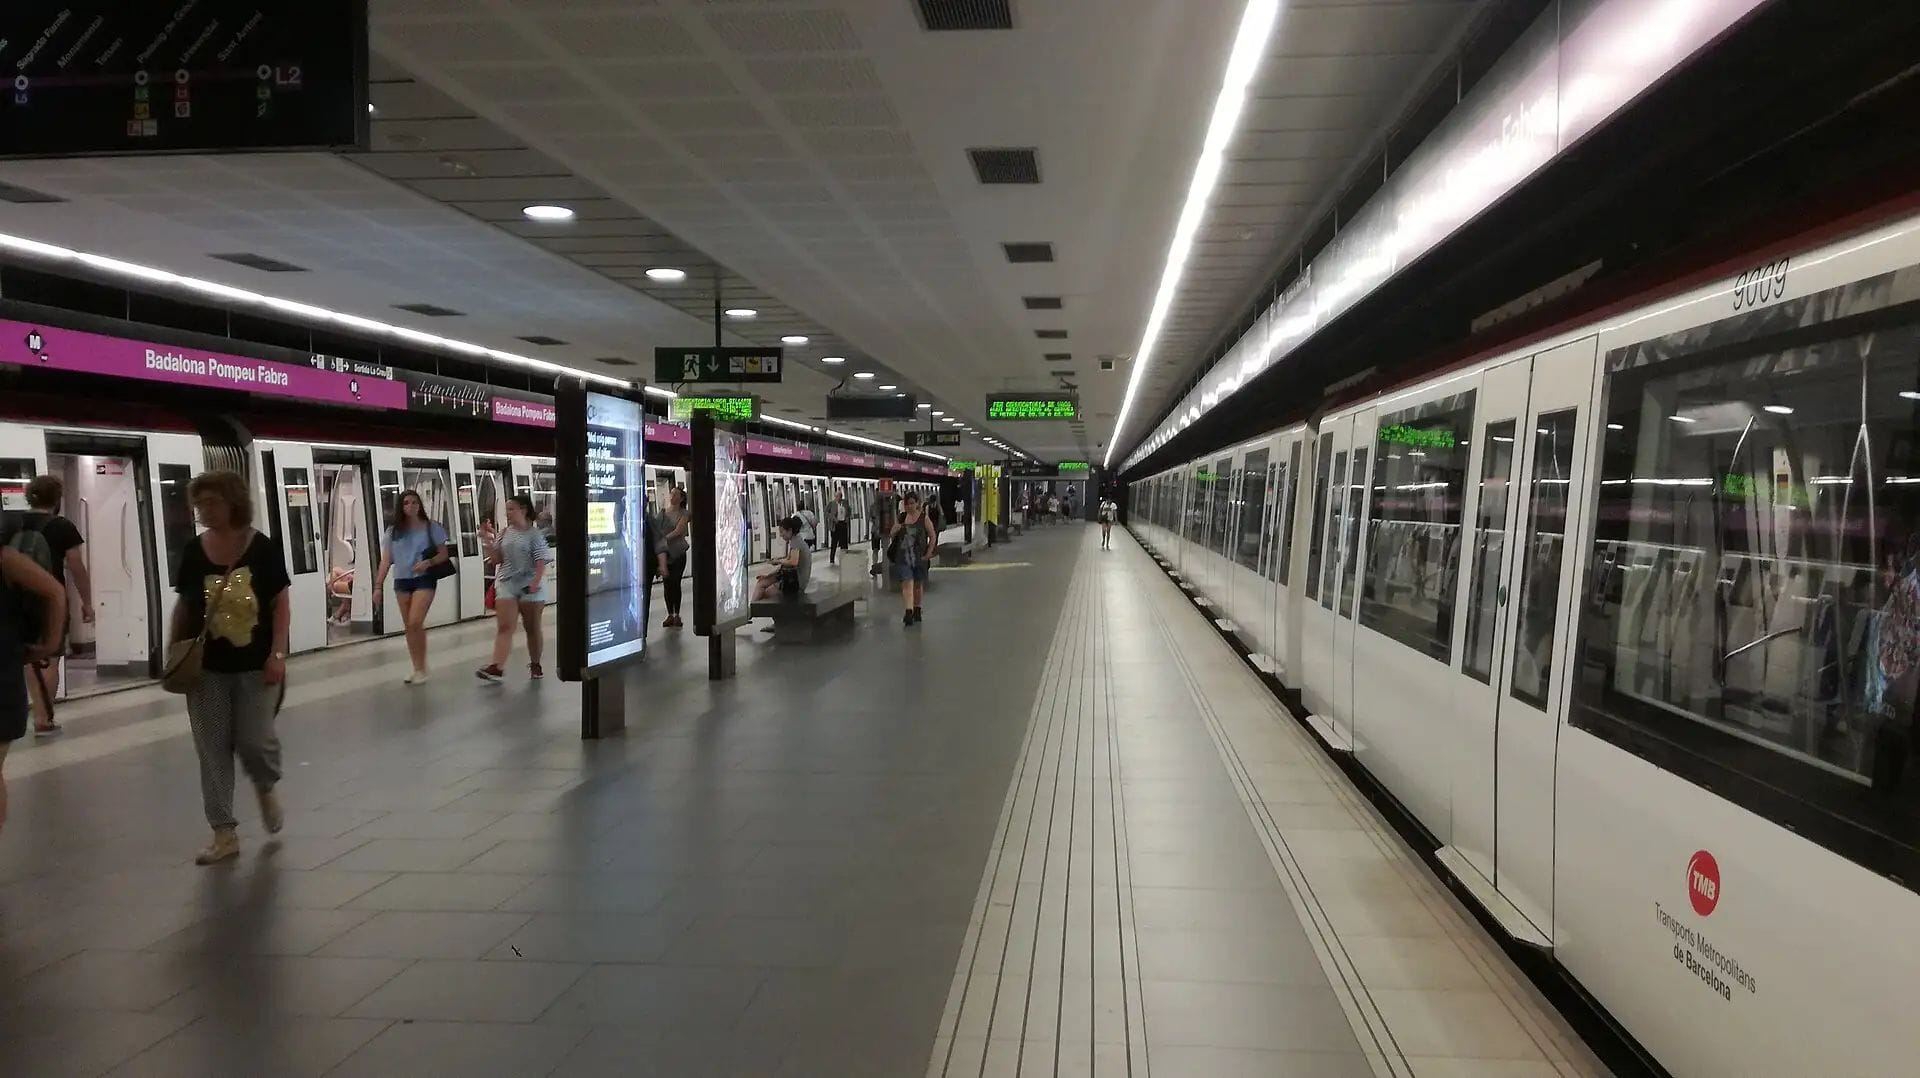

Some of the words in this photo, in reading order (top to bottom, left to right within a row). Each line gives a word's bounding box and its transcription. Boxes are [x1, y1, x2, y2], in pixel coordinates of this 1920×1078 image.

[57, 14, 105, 68] Monumental
[276, 66, 302, 85] L2
[1733, 257, 1790, 311] 9009
[145, 349, 206, 376] Badalona
[208, 358, 256, 383] Pompeu
[257, 365, 288, 386] Fabra
[495, 401, 521, 417] Badalona
[522, 405, 542, 421] Pompeu
[543, 409, 556, 421] Fabr
[1692, 870, 1717, 900] TMB
[1655, 902, 1695, 948] Transports
[1696, 932, 1756, 994] Metropolitans
[1673, 942, 1684, 964] de
[1686, 949, 1731, 1002] Barcelona
